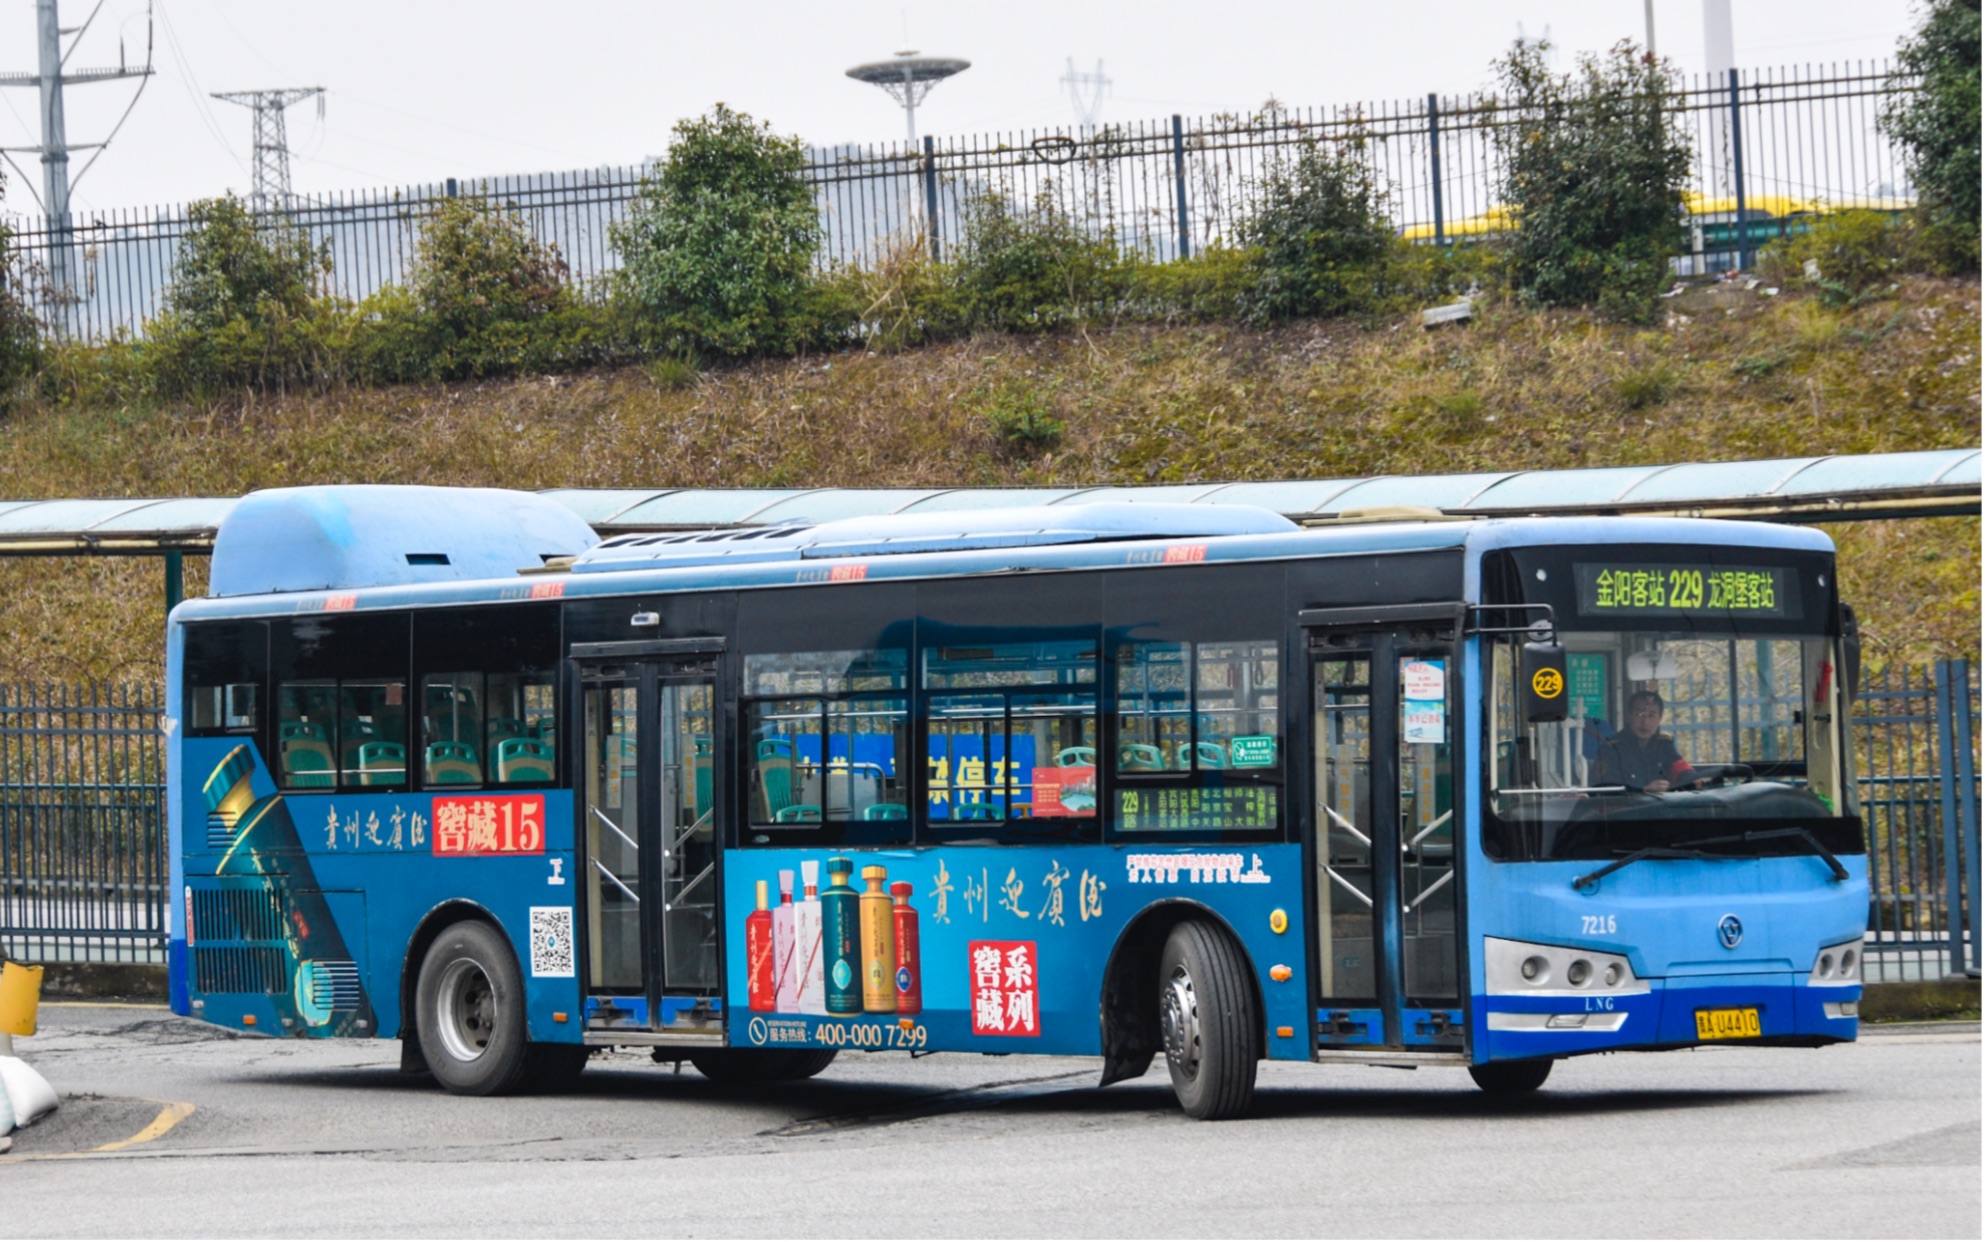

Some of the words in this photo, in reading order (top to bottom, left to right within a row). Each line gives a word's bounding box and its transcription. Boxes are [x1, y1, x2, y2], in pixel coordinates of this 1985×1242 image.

[1596, 568, 1665, 608] 金阳客站
[1669, 569, 1703, 609] 229
[1707, 571, 1775, 609] 龙洞堡客站
[1537, 674, 1560, 692] 229
[1122, 790, 1139, 813] 229
[436, 799, 541, 852] 窖藏15
[1581, 915, 1617, 935] 7216
[1585, 997, 1614, 1012] LNG
[815, 1023, 882, 1046] 400-000
[884, 1024, 928, 1048] 7299
